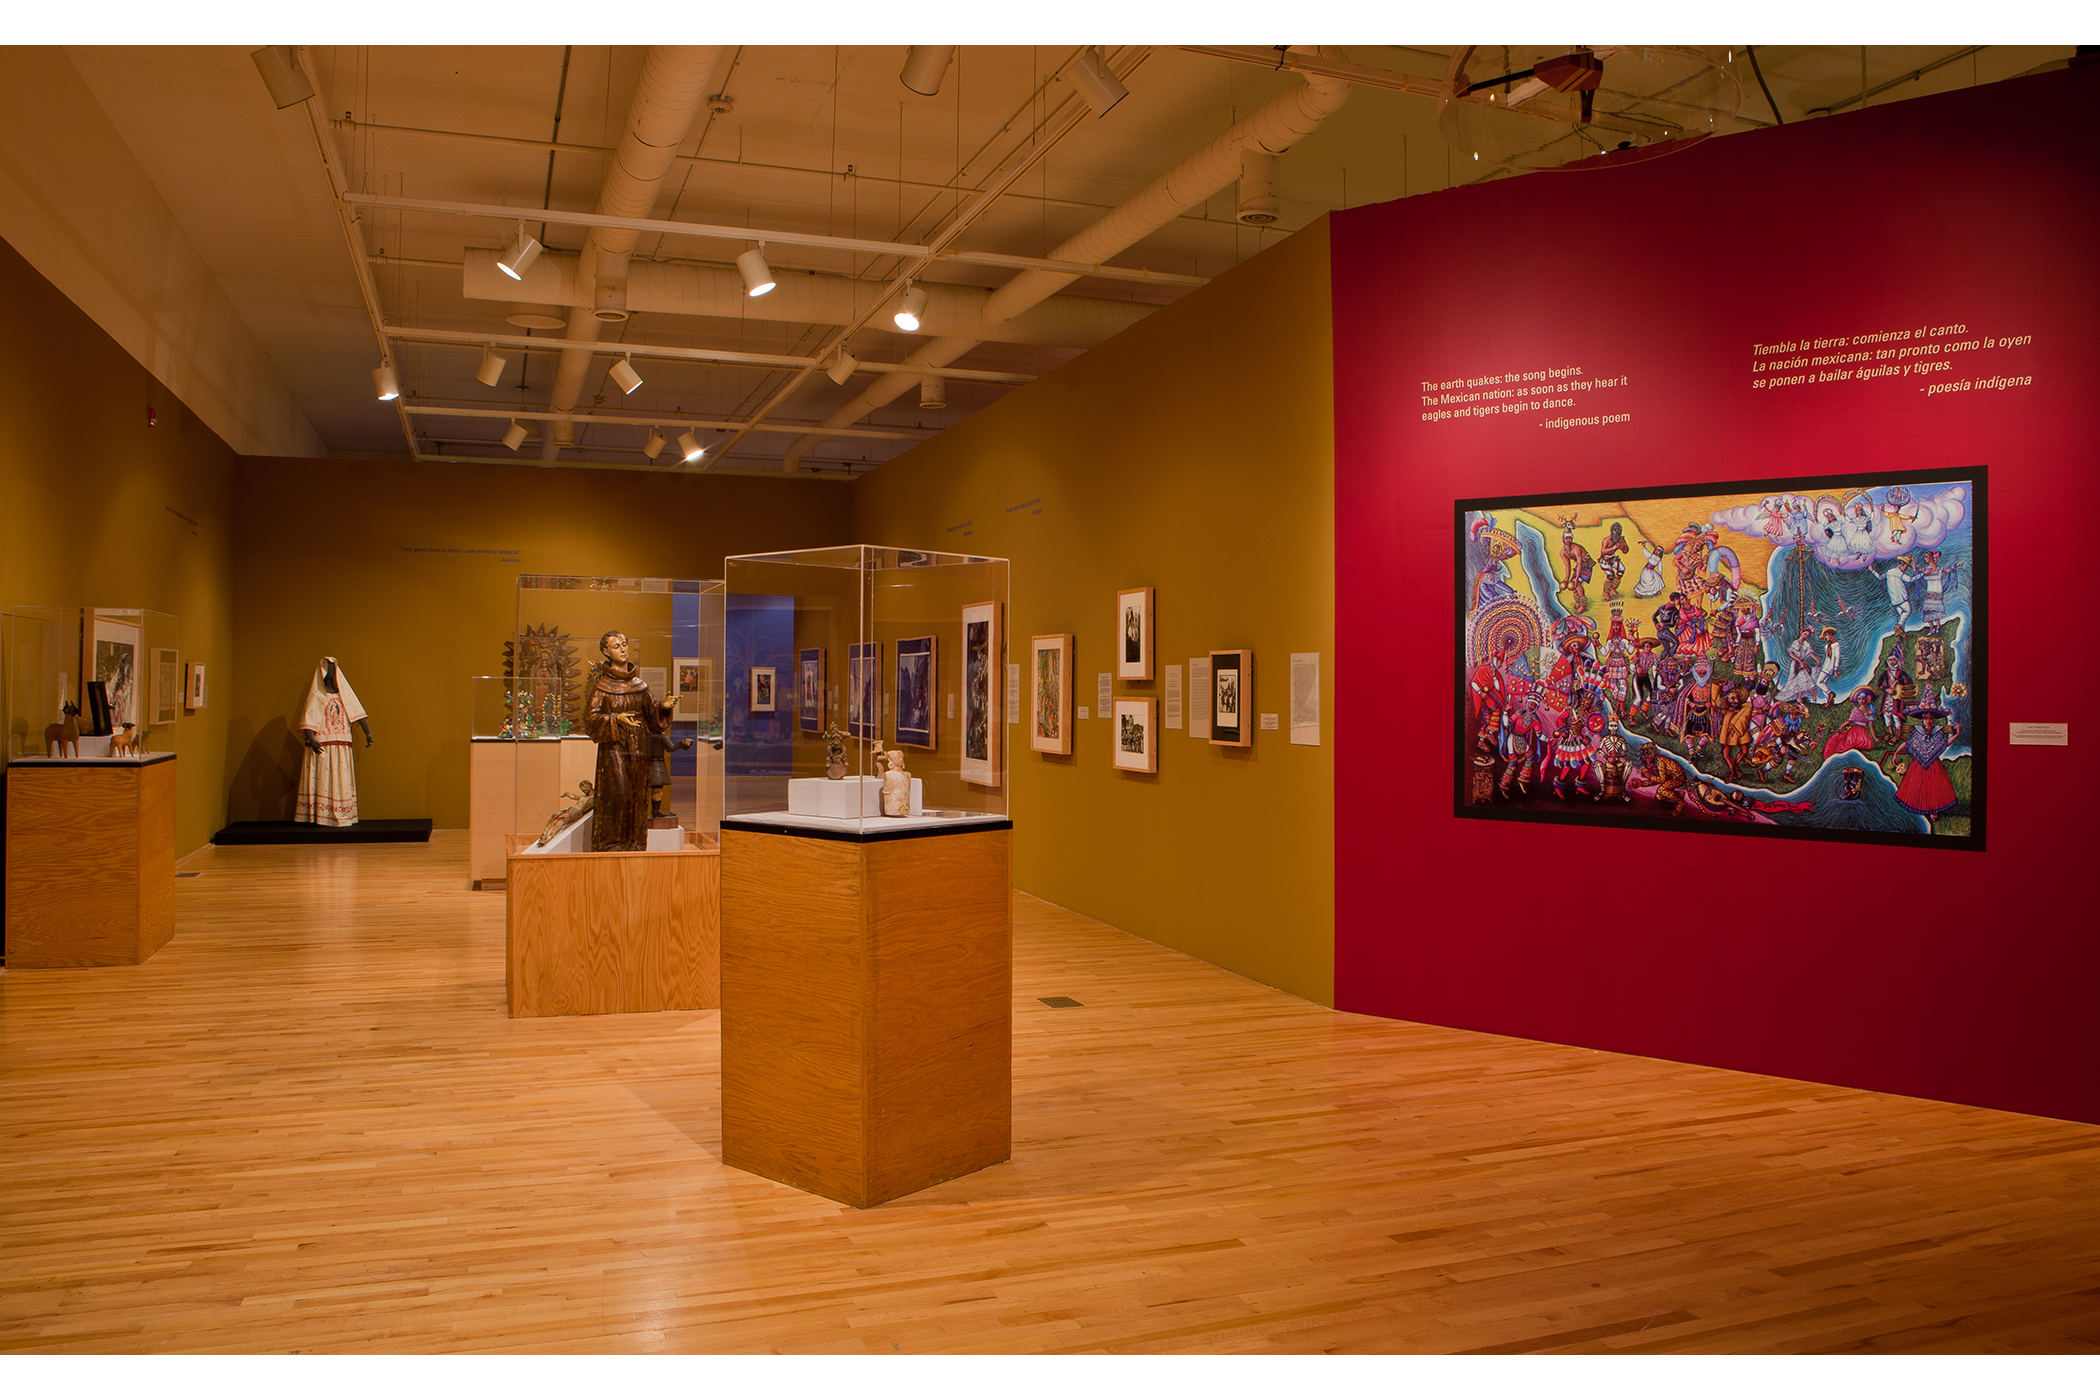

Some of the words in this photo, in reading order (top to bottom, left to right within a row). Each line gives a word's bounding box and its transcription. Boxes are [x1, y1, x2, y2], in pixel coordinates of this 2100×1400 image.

[1753, 341, 1797, 355] Tiembla
[1800, 339, 1811, 351] la
[1814, 337, 1850, 350] tierra:
[1853, 330, 1911, 345] comienza
[1914, 326, 1928, 339] el
[1930, 324, 1968, 337] canto.
[1753, 361, 1766, 372] La
[1769, 356, 1808, 370] nación
[1811, 352, 1873, 366] mexicana:
[1876, 349, 1896, 360] tan
[1898, 344, 1940, 360] pronto
[1944, 341, 1979, 353] como
[1983, 336, 1995, 349] la
[1999, 335, 2031, 349] oyen
[1421, 382, 1439, 393] The
[1441, 378, 1465, 391] earth
[1467, 374, 1503, 390] quakes:
[1505, 371, 1521, 383] the
[1523, 371, 1546, 382] song
[1549, 366, 1584, 379] begins.
[1753, 379, 1767, 389] se
[1769, 375, 1806, 390] ponen
[1808, 374, 1816, 384] a
[1819, 369, 1854, 383] bailar
[1856, 364, 1900, 380] águilas
[1903, 365, 1912, 378] y
[1914, 361, 1953, 376] tigres.
[1928, 379, 1971, 397] poesía
[1974, 375, 2032, 391] indígena
[1421, 396, 1439, 407] The
[1441, 392, 1480, 405] Mexican
[1483, 388, 1515, 401] nation:
[1517, 388, 1528, 397] as
[1531, 385, 1554, 395] soon
[1557, 383, 1569, 392] as
[1570, 380, 1593, 393] they
[1595, 378, 1619, 389] hear
[1621, 375, 1628, 386] it
[1422, 409, 1452, 423] eagles
[1454, 406, 1471, 418] and
[1473, 404, 1500, 418] tigers
[1502, 401, 1529, 415] begin
[1531, 401, 1541, 411] to
[1543, 398, 1576, 409] dance.
[1545, 416, 1600, 430] indigenous
[1602, 413, 1631, 427] poem
